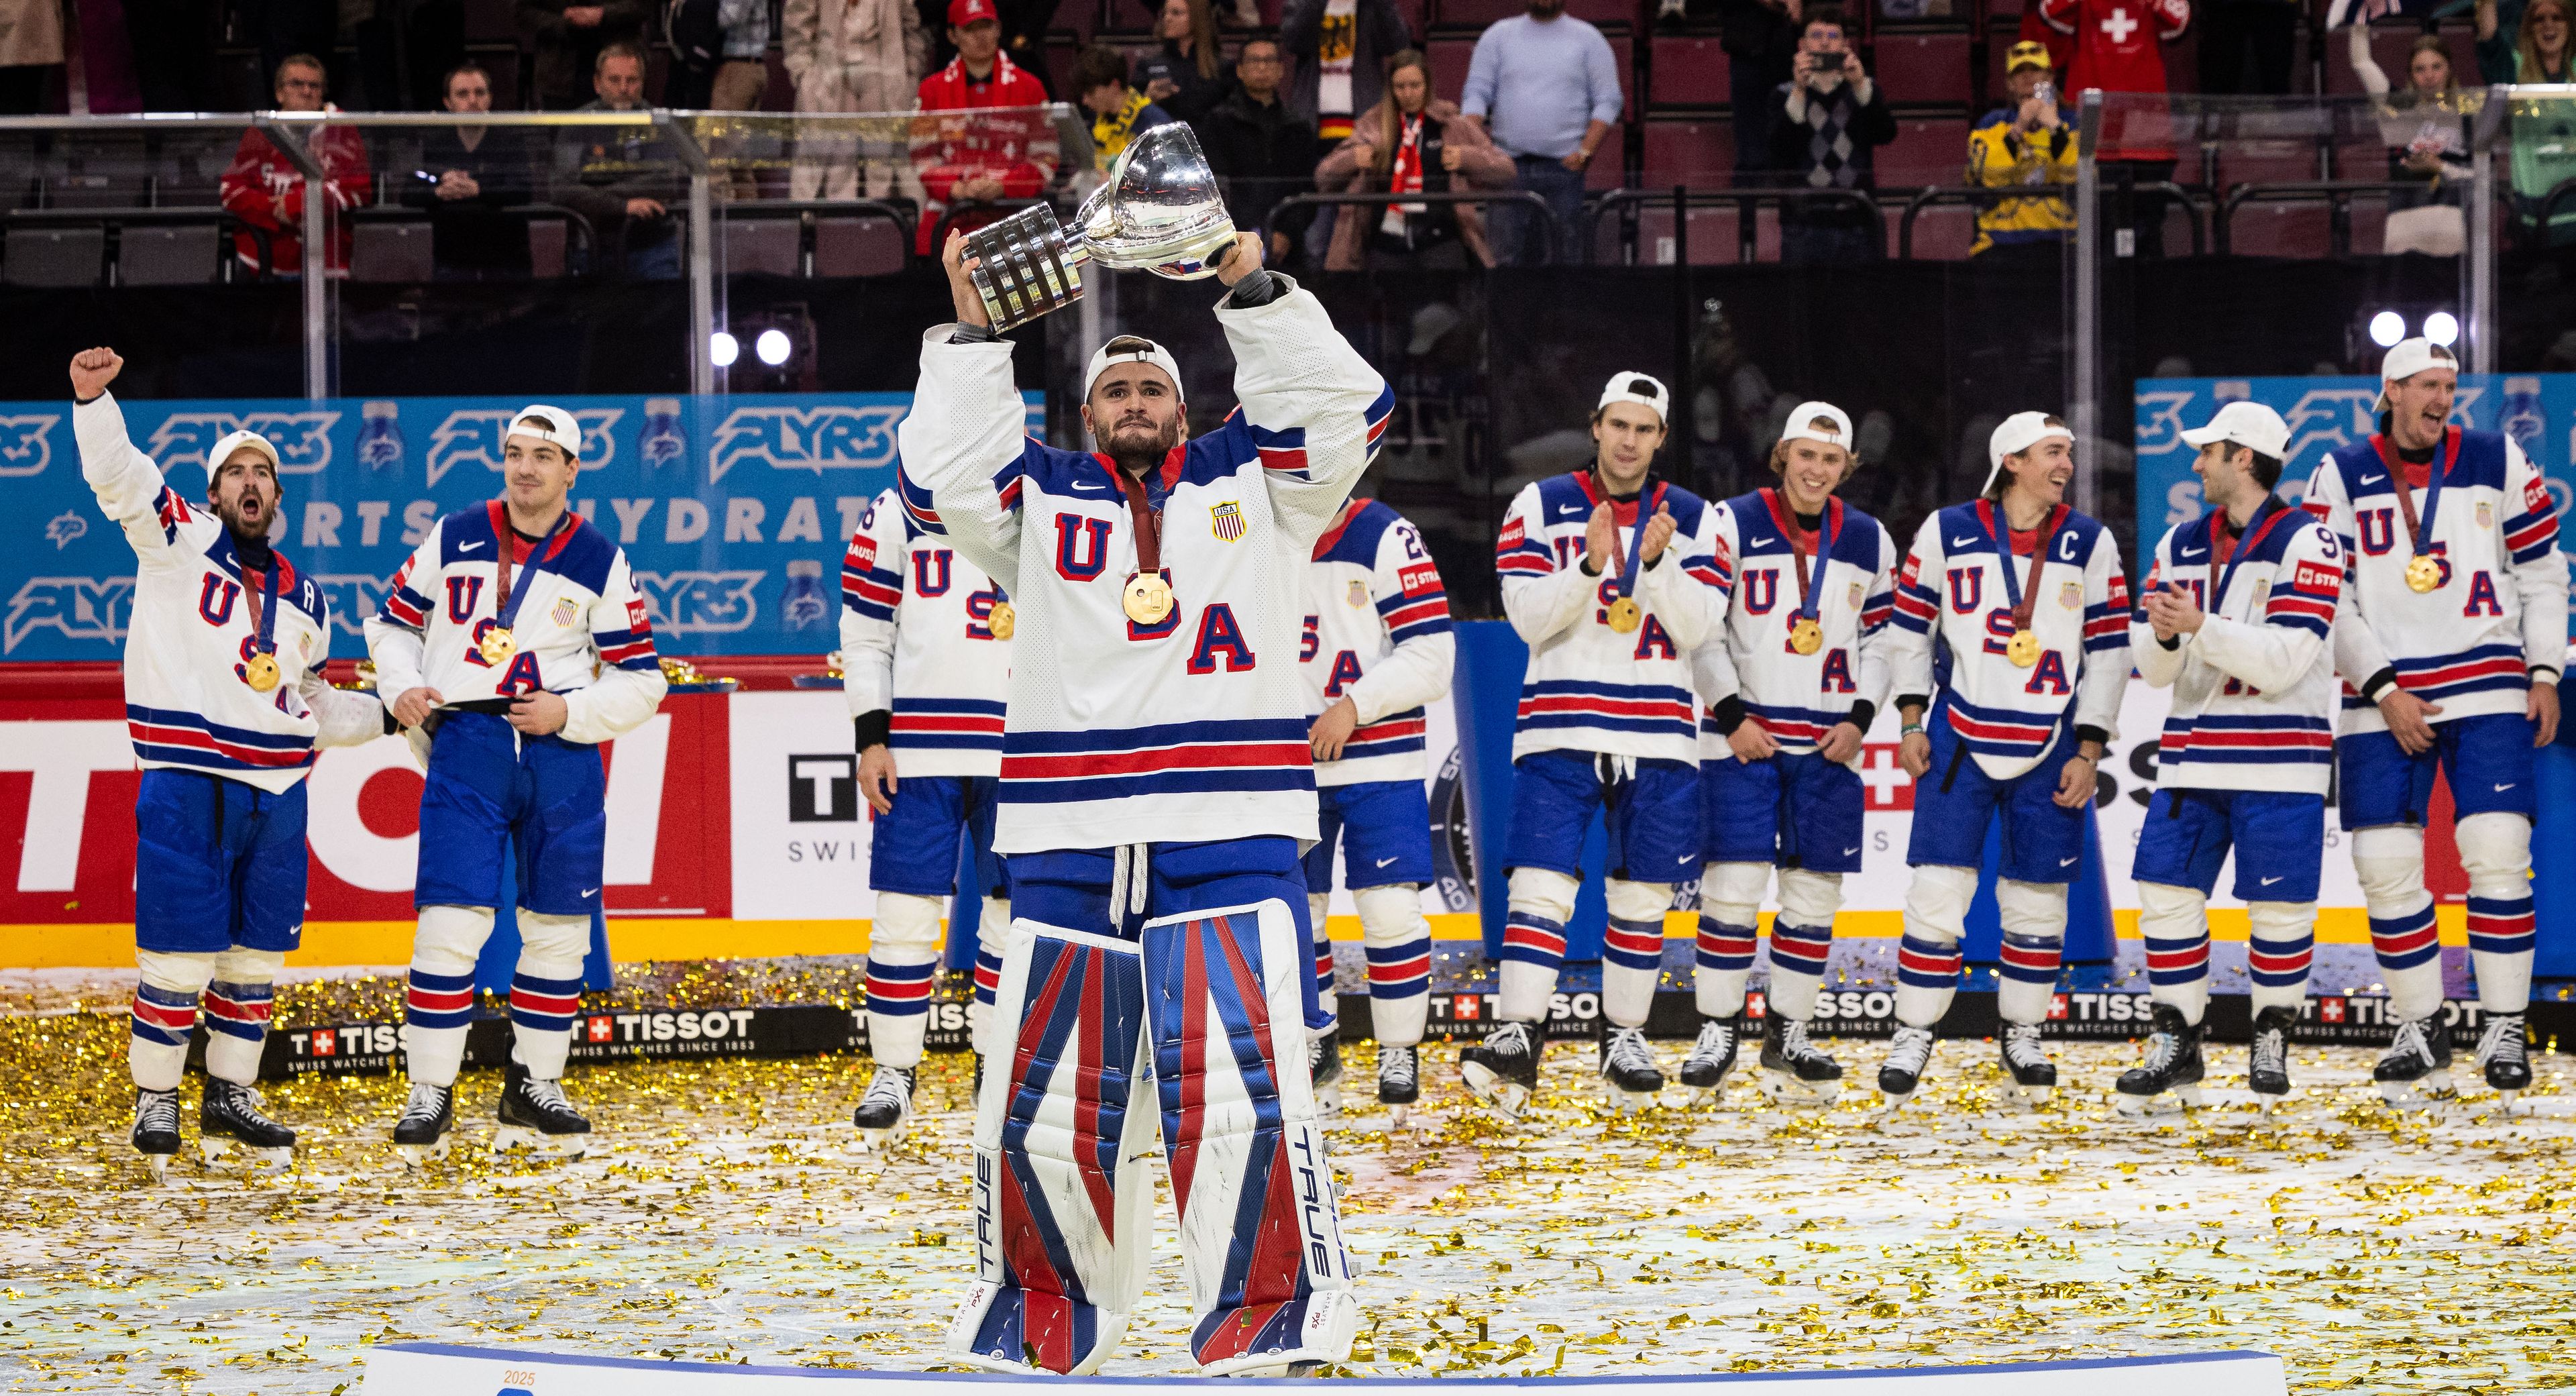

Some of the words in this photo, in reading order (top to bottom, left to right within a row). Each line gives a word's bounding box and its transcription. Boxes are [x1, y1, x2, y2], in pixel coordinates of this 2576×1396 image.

[1216, 506, 1236, 516] USA
[2059, 531, 2079, 561] C
[303, 580, 315, 614] A
[796, 761, 851, 816] T
[1430, 997, 1450, 1018] T
[2071, 993, 2154, 1021] TISS
[616, 1010, 755, 1042] TISSOT
[1427, 1023, 1470, 1034] SWISS
[1549, 1022, 1589, 1033] SINCE
[1839, 1021, 1880, 1032] SINCE
[2065, 1023, 2129, 1034] WATCHES
[2294, 1026, 2337, 1037] SWISS
[290, 1034, 309, 1055] T
[339, 1026, 408, 1055] TISS
[570, 1046, 603, 1057] WISS
[610, 1043, 672, 1056] WATCHES
[678, 1041, 718, 1053] SINCE
[288, 1059, 327, 1072] SWISS
[333, 1055, 394, 1069] WATCHES
[979, 1152, 991, 1276] TRUE
[1295, 1125, 1332, 1279] TRUE
[953, 1287, 977, 1334] CATALYST
[504, 1369, 536, 1386] 2025
